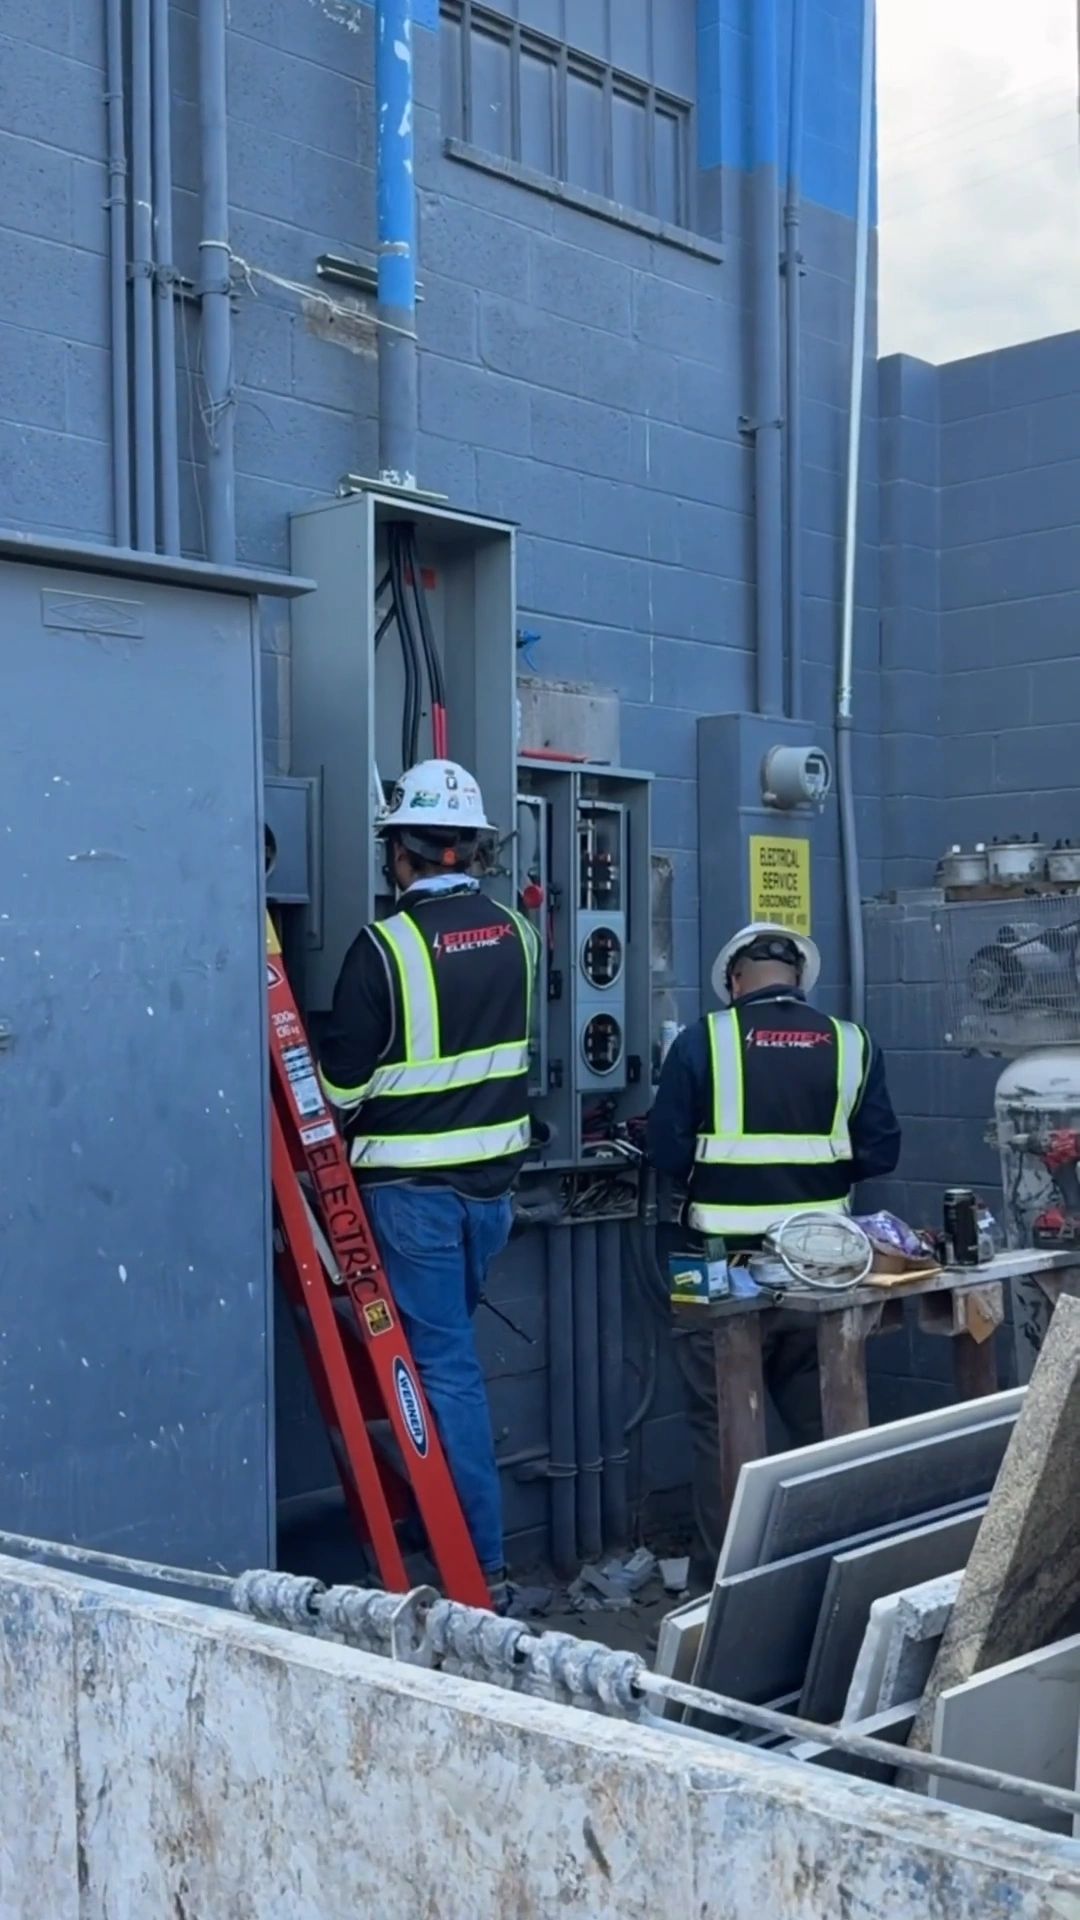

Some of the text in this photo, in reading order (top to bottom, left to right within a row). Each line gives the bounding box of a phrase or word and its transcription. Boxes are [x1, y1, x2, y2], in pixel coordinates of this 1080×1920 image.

[760, 846, 801, 869] ELECTRICAL
[762, 871, 798, 891] SERVICE
[445, 937, 501, 953] ELECTRIC
[756, 1040, 816, 1049] ELECTRIC
[307, 1143, 380, 1305] ELECTRIC
[399, 1376, 423, 1437] WERNER
